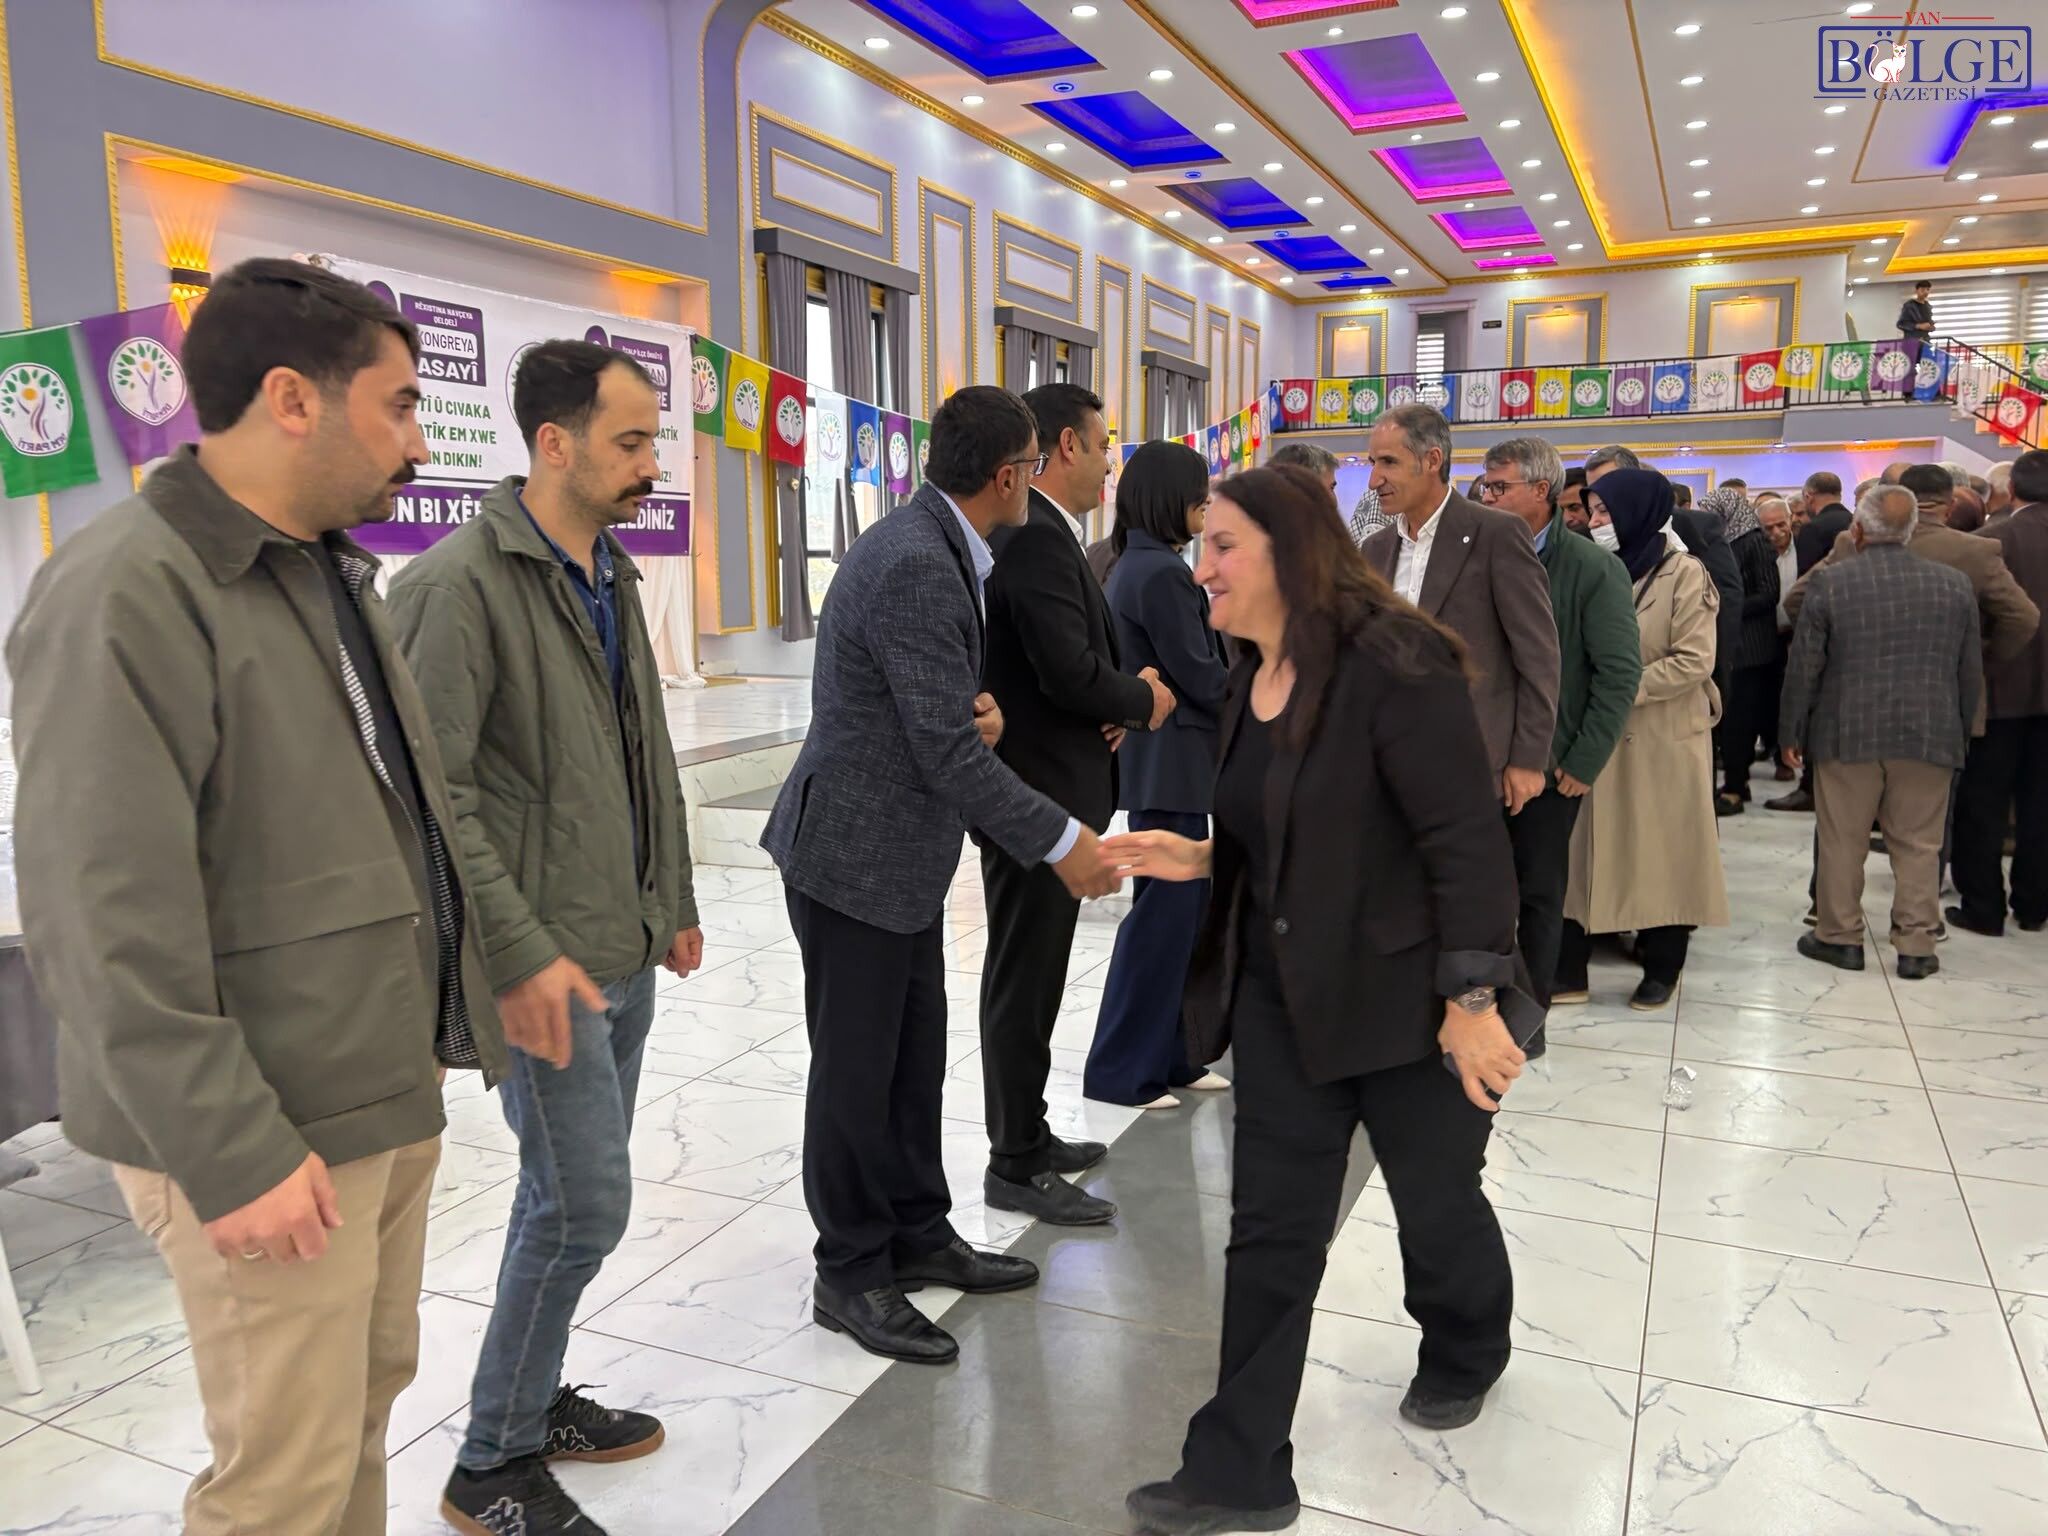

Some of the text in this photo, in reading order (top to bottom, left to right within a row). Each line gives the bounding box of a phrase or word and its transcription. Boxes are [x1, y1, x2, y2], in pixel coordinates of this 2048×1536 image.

[417, 357, 479, 382] ASAYÎ
[445, 400, 491, 420] CIVAKA
[449, 426, 467, 442] EM
[469, 428, 497, 445] XWE
[443, 452, 482, 468] DIKIN!
[419, 497, 441, 524] BI
